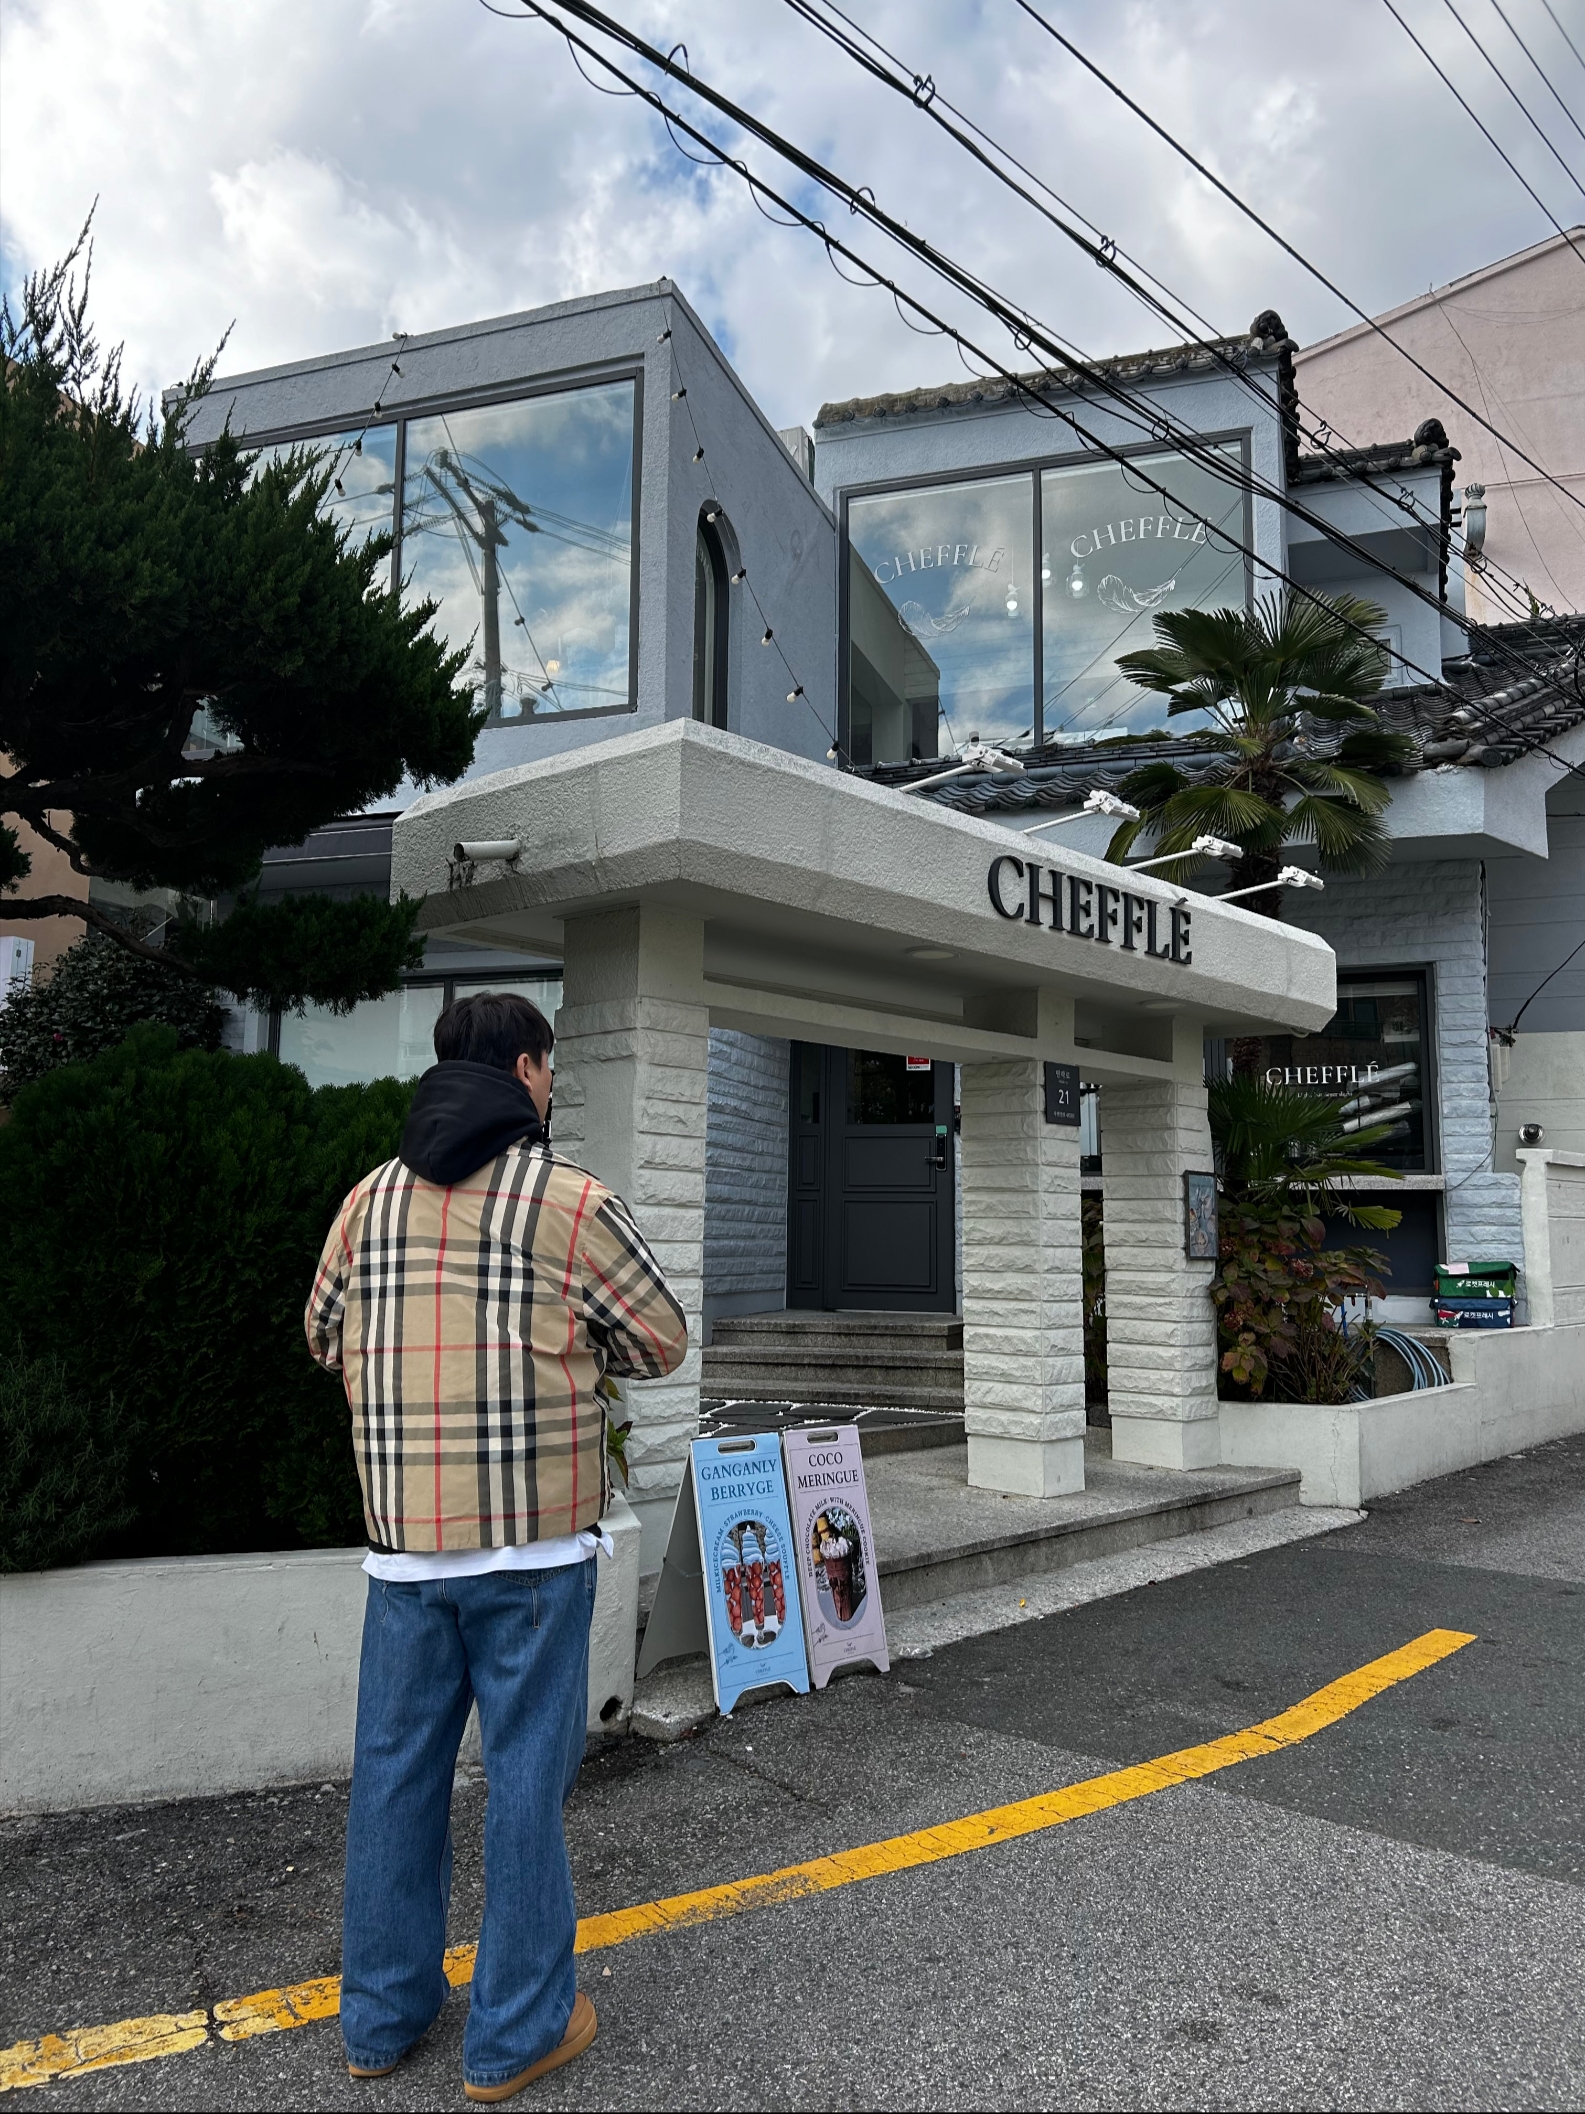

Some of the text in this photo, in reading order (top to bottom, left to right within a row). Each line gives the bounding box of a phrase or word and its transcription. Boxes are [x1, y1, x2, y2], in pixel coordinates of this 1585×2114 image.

[1070, 515, 1212, 558] CHEFFLÉ
[873, 544, 1005, 584] CHEFFLÉ
[987, 854, 1193, 965] CHEFFLÉ
[1265, 1060, 1380, 1085] CHEFFLÉ
[1058, 1089, 1069, 1105] 21
[1465, 1280, 1496, 1289] 로켓프레시
[1463, 1310, 1494, 1320] 로켓프레시
[701, 1459, 777, 1481] GANGANLY
[808, 1451, 843, 1467] COCO
[797, 1469, 859, 1489] MERINGUE
[710, 1480, 774, 1501] BERRYGE
[723, 1508, 764, 1527] STRAWBERRY
[765, 1515, 784, 1542] CHEESE
[804, 1508, 816, 1555] CHOCOLATE
[814, 1497, 828, 1511] MILK
[830, 1496, 844, 1504] WITH
[844, 1501, 866, 1535] MERINGUE
[862, 1536, 870, 1565] COOKIE
